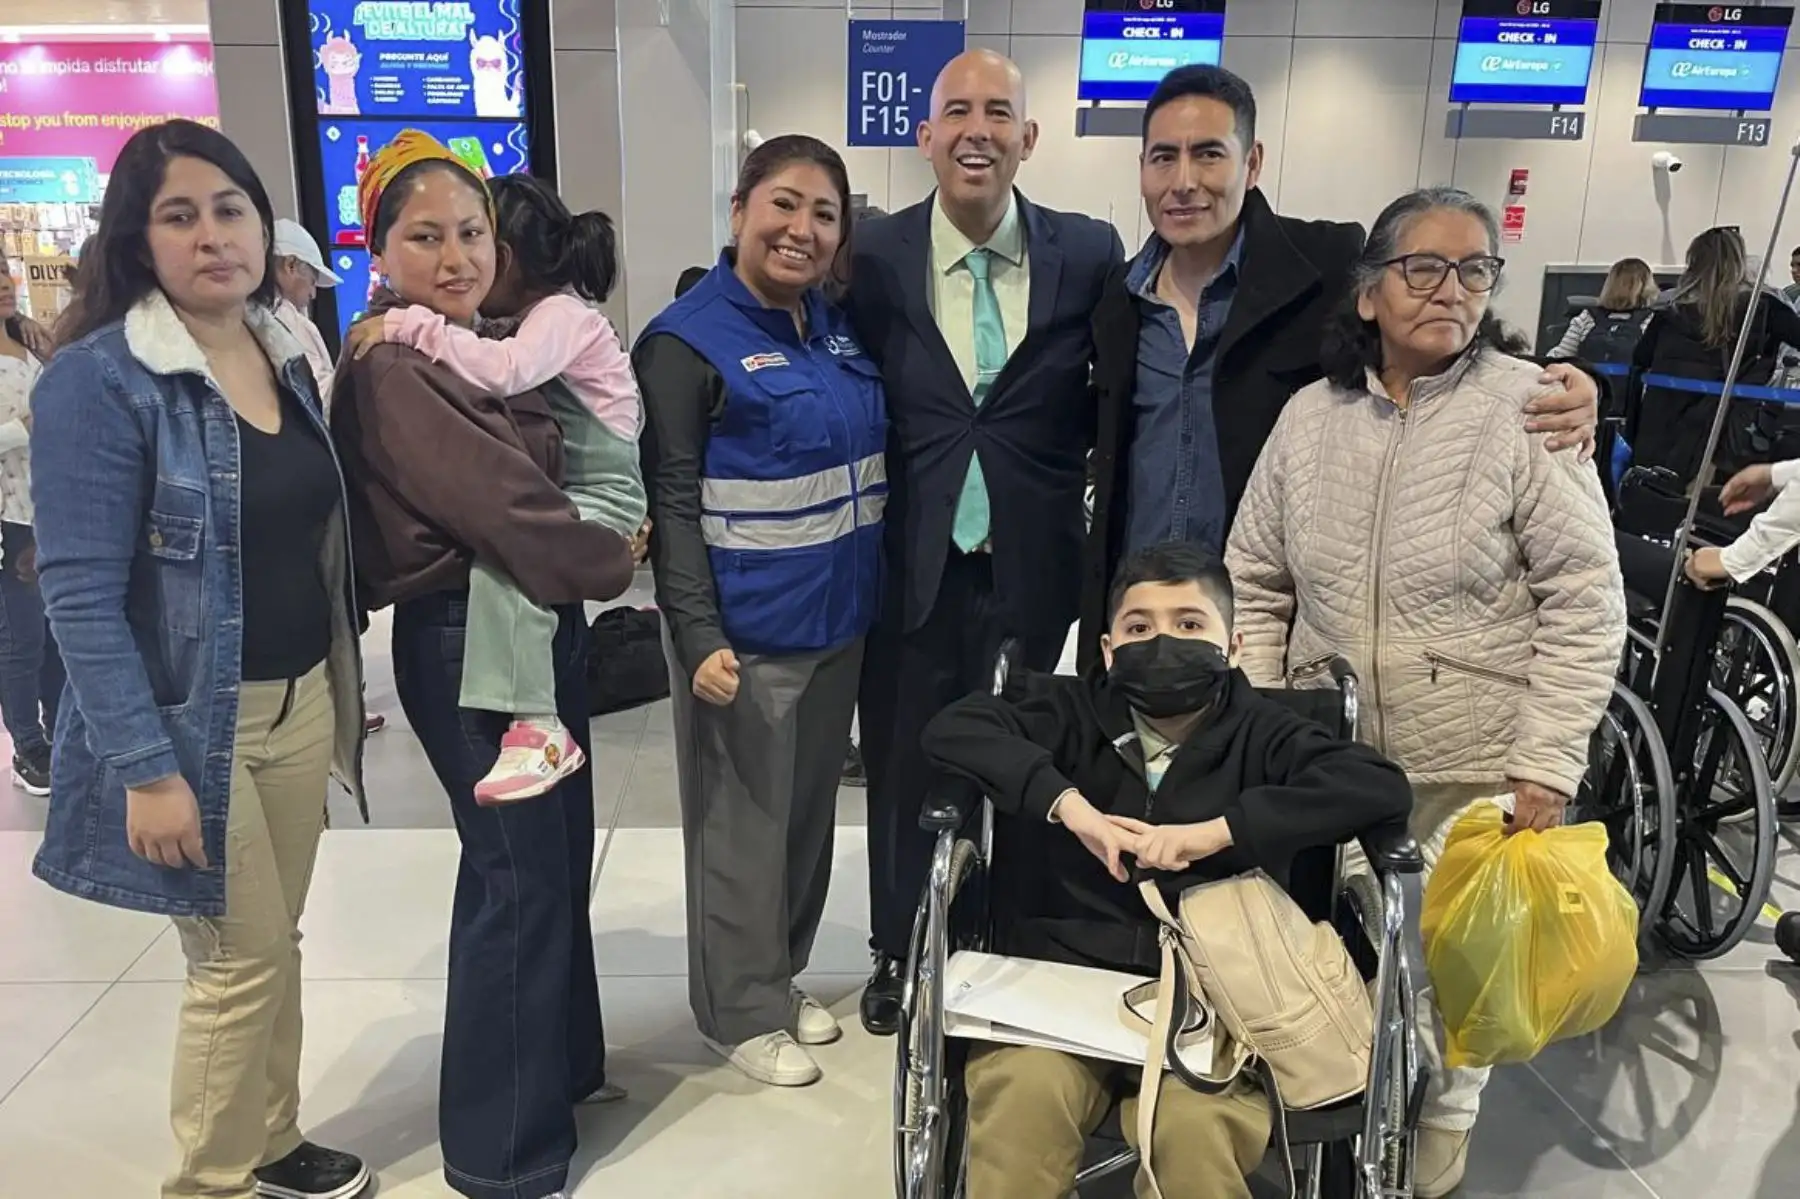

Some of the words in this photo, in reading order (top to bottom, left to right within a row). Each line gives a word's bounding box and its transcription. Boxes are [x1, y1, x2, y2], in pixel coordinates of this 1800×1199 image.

[1156, 0, 1174, 8] LG
[1532, 2, 1550, 14] LG
[1724, 9, 1741, 20] LG
[862, 30, 907, 41] Mostrador
[1123, 27, 1160, 38] CHECK
[1170, 27, 1184, 39] IN
[1498, 32, 1535, 43] CHECK
[1544, 33, 1557, 44] IN
[862, 43, 895, 54] Counter
[1689, 38, 1725, 50] CHECK
[1734, 40, 1748, 50] IN
[94, 56, 158, 74] disfrutar
[862, 71, 922, 102] F01-
[33, 114, 61, 131] you
[63, 110, 99, 127] from
[862, 105, 910, 136] F15
[1551, 117, 1578, 135] F14
[1737, 123, 1765, 142] F13
